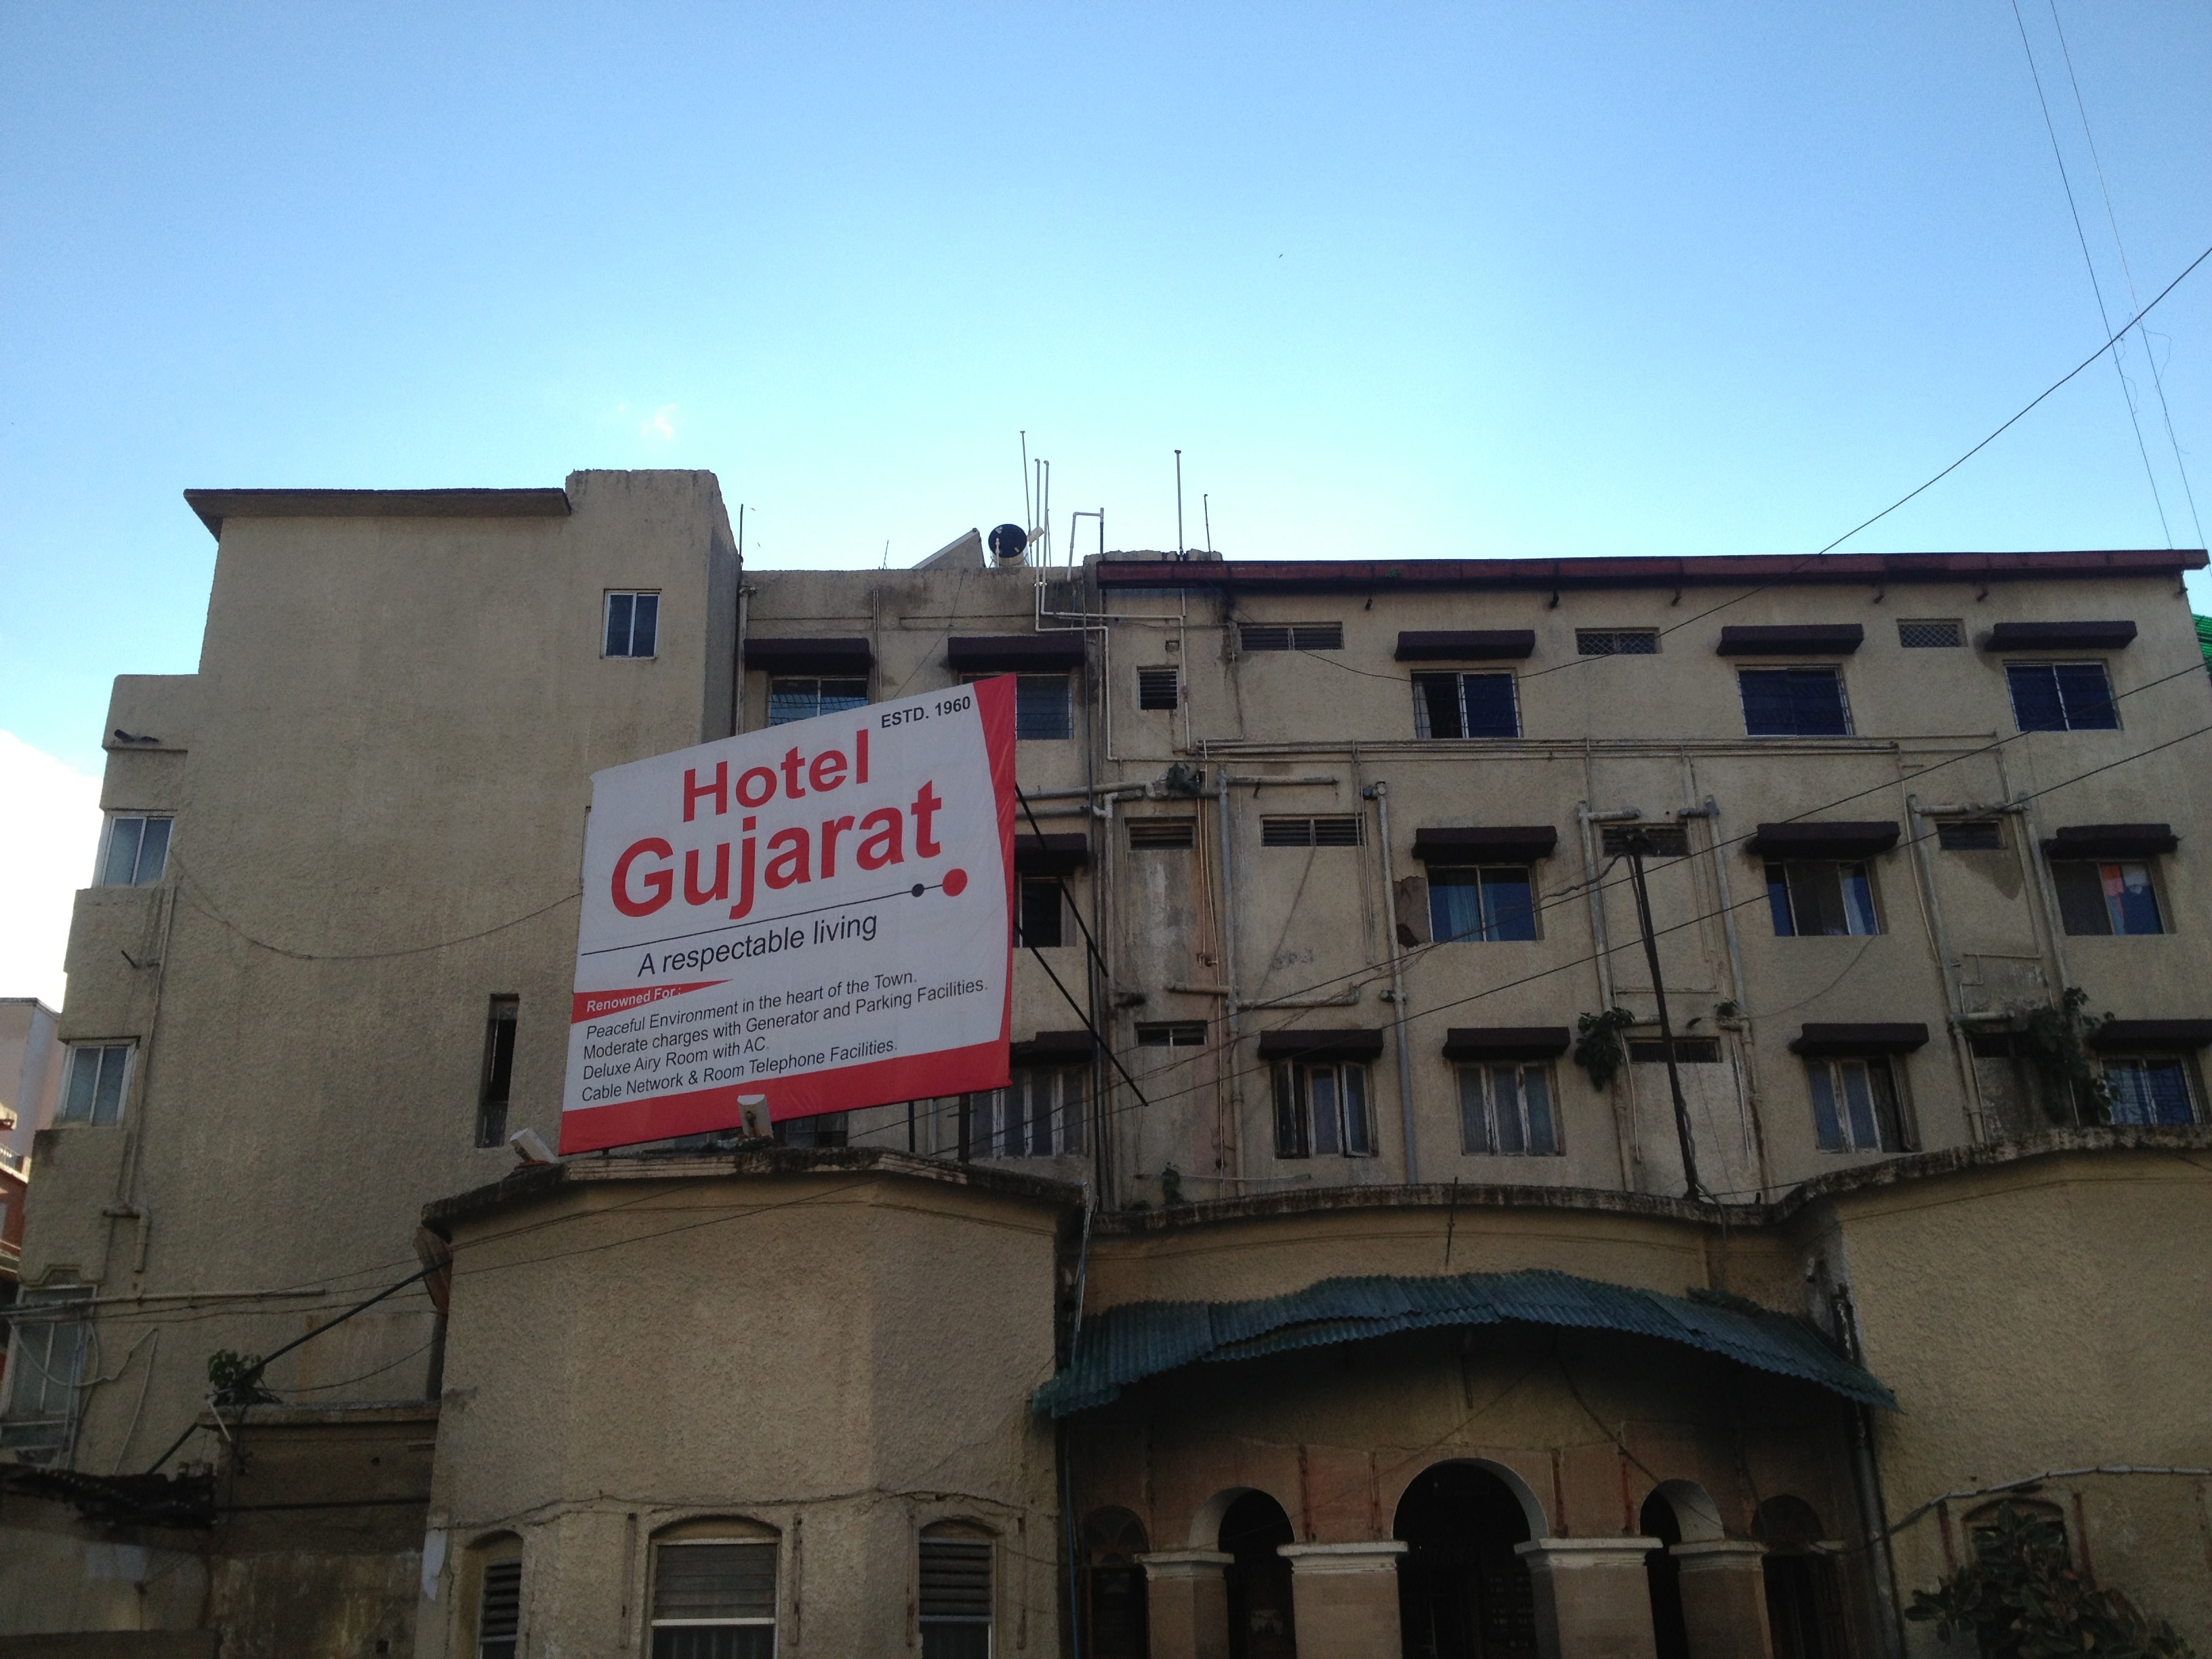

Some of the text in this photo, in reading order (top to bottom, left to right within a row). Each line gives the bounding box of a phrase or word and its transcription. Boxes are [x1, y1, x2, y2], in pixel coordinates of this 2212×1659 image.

[881, 696, 971, 729] ESTD. 1960
[683, 729, 869, 823] Hotel
[611, 779, 942, 920] Gujarat
[637, 914, 878, 977] A respectable living
[583, 979, 988, 1060] Moderate charges with Generator and Parking Facilities.
[586, 991, 651, 1012] Renowned
[586, 972, 917, 1040] Peaceful Environment in the heart of the Town.
[581, 1040, 897, 1102] Cable Network & Room Telephone Facilities.
[583, 1061, 631, 1080] Deluxe
[634, 1056, 661, 1073] Airy
[665, 1050, 708, 1067] Room
[713, 1042, 740, 1059] with
